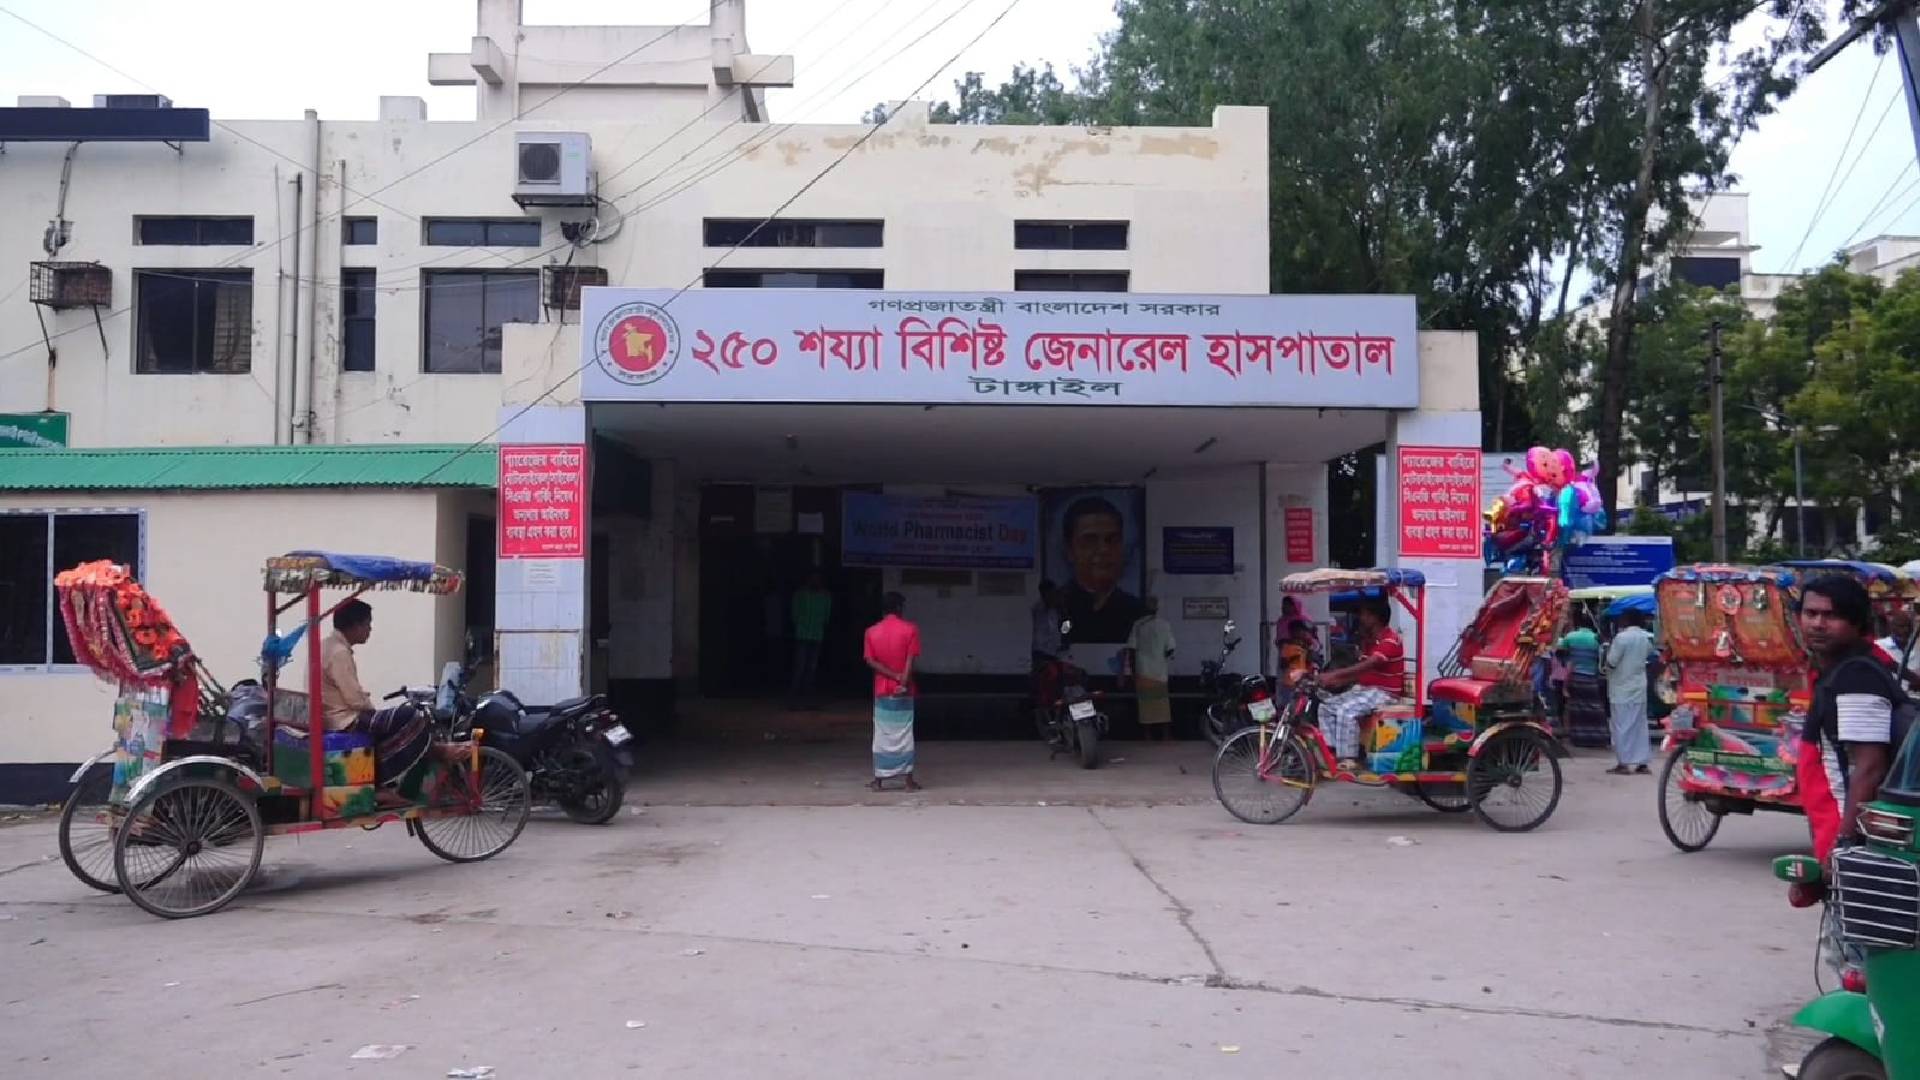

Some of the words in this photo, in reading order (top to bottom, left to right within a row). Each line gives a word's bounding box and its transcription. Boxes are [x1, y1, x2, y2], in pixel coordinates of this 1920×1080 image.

[868, 297, 1007, 315] গণপ্রজাতন্ত্রী
[1015, 301, 1129, 316] বাংলাদেশ
[1139, 302, 1221, 317] সরকার
[691, 328, 779, 375] ২৫০
[793, 323, 884, 373] শয্যা
[894, 316, 1008, 373] বিশিষ্ট
[1024, 328, 1190, 373] জেনারেল
[1201, 328, 1397, 378] হাসপাতাল
[967, 375, 1124, 399] টাঙ্গাইল
[904, 520, 993, 542] Pharmacist
[998, 523, 1027, 544] Day
